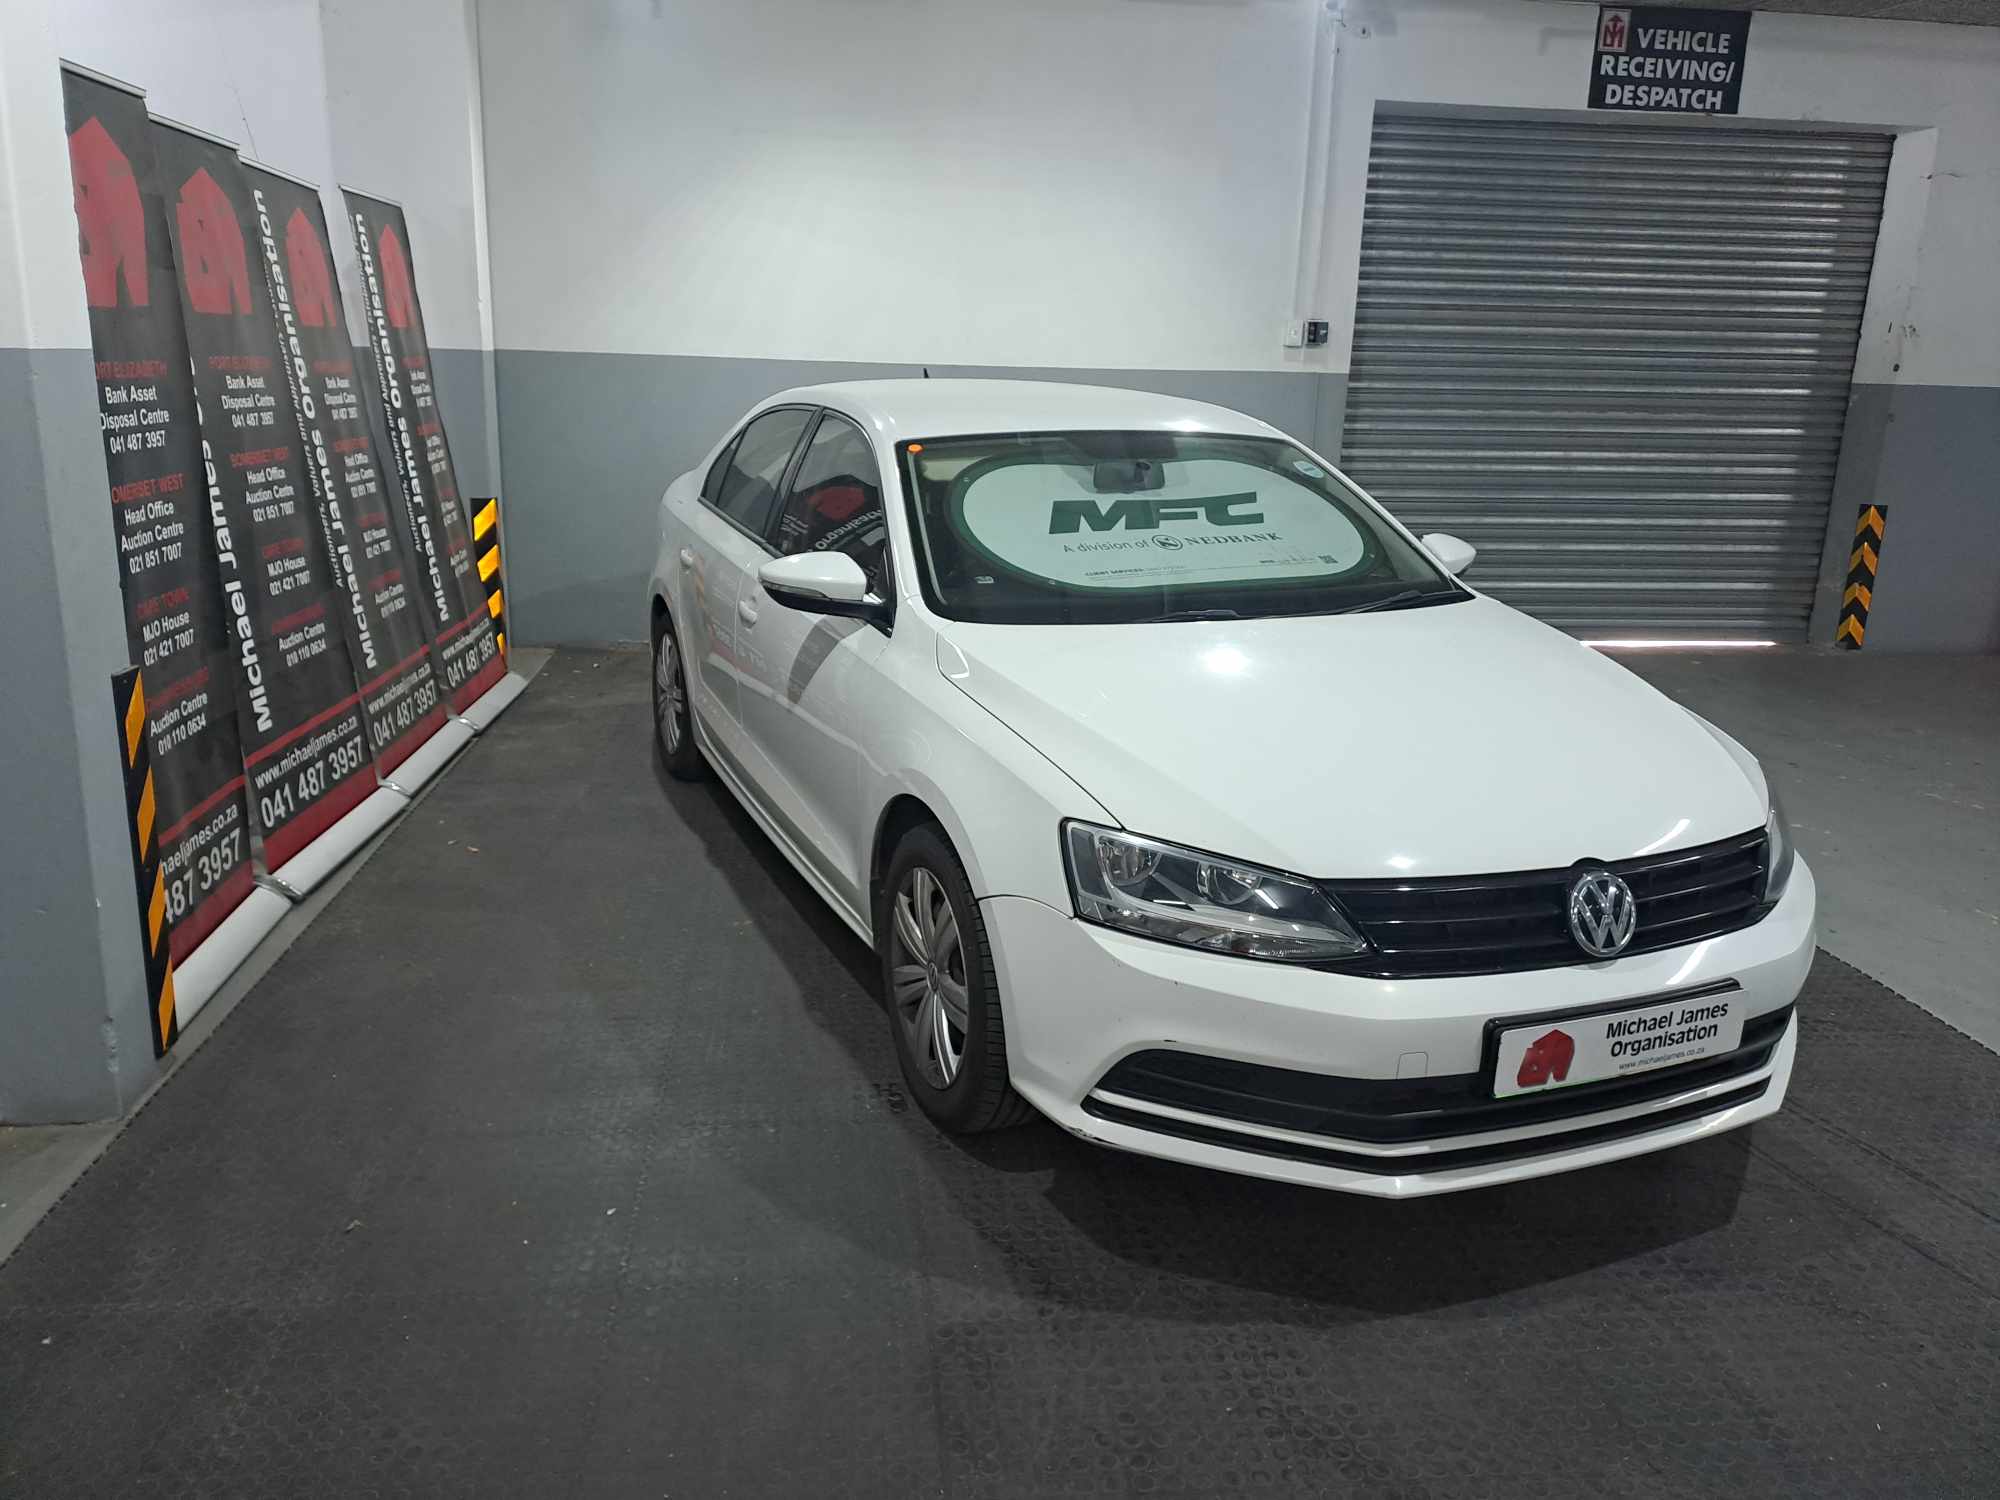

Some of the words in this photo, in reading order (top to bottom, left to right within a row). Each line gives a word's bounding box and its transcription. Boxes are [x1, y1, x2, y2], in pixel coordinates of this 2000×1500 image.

[1637, 28, 1731, 54] VEHICLE
[1600, 55, 1735, 83] RECEIVING/
[1605, 84, 1723, 110] DESPATCH
[253, 189, 316, 420] Organisation
[356, 213, 402, 409] Organisation
[105, 386, 129, 404] Bank
[130, 384, 157, 402] Asset
[100, 409, 138, 432] Disposal
[140, 408, 170, 425] Centre
[110, 436, 126, 454] 041
[127, 433, 142, 450] 487
[145, 430, 166, 449] 3957
[398, 417, 424, 508] James
[312, 429, 345, 536] James
[124, 505, 146, 526] Head
[147, 501, 174, 519] Office
[1049, 492, 1264, 534] MFC
[122, 531, 153, 552] Auction
[155, 523, 184, 541] Centre
[1064, 544, 1074, 554] A
[1077, 540, 1133, 553] division
[1135, 539, 1152, 550] of
[1184, 532, 1284, 546] NEDBANK
[129, 556, 143, 574] 021
[145, 549, 160, 568] 851
[162, 542, 182, 562] 7007
[417, 515, 449, 622] Michael
[337, 545, 377, 669] Michael
[143, 618, 161, 642] MJO
[161, 612, 190, 633] House
[278, 635, 304, 652] Auction
[144, 646, 159, 666] 021
[159, 638, 173, 657] 421
[174, 629, 194, 650] 7007
[225, 580, 272, 732] Michael
[447, 659, 466, 688] 041
[465, 645, 481, 673] 487
[150, 708, 180, 736] Auction
[181, 693, 208, 716] Centre
[172, 725, 187, 745] 110
[187, 712, 207, 736] 0634
[373, 712, 396, 747] 041
[396, 696, 415, 729] 487
[414, 679, 437, 714] 3957
[261, 783, 294, 828] 041
[298, 760, 325, 801] 487
[328, 735, 362, 780] 3957
[198, 826, 241, 890] 3957
[1606, 1011, 1674, 1039] Michael
[1677, 1003, 1728, 1026] James
[1610, 1023, 1718, 1057] Organisation
